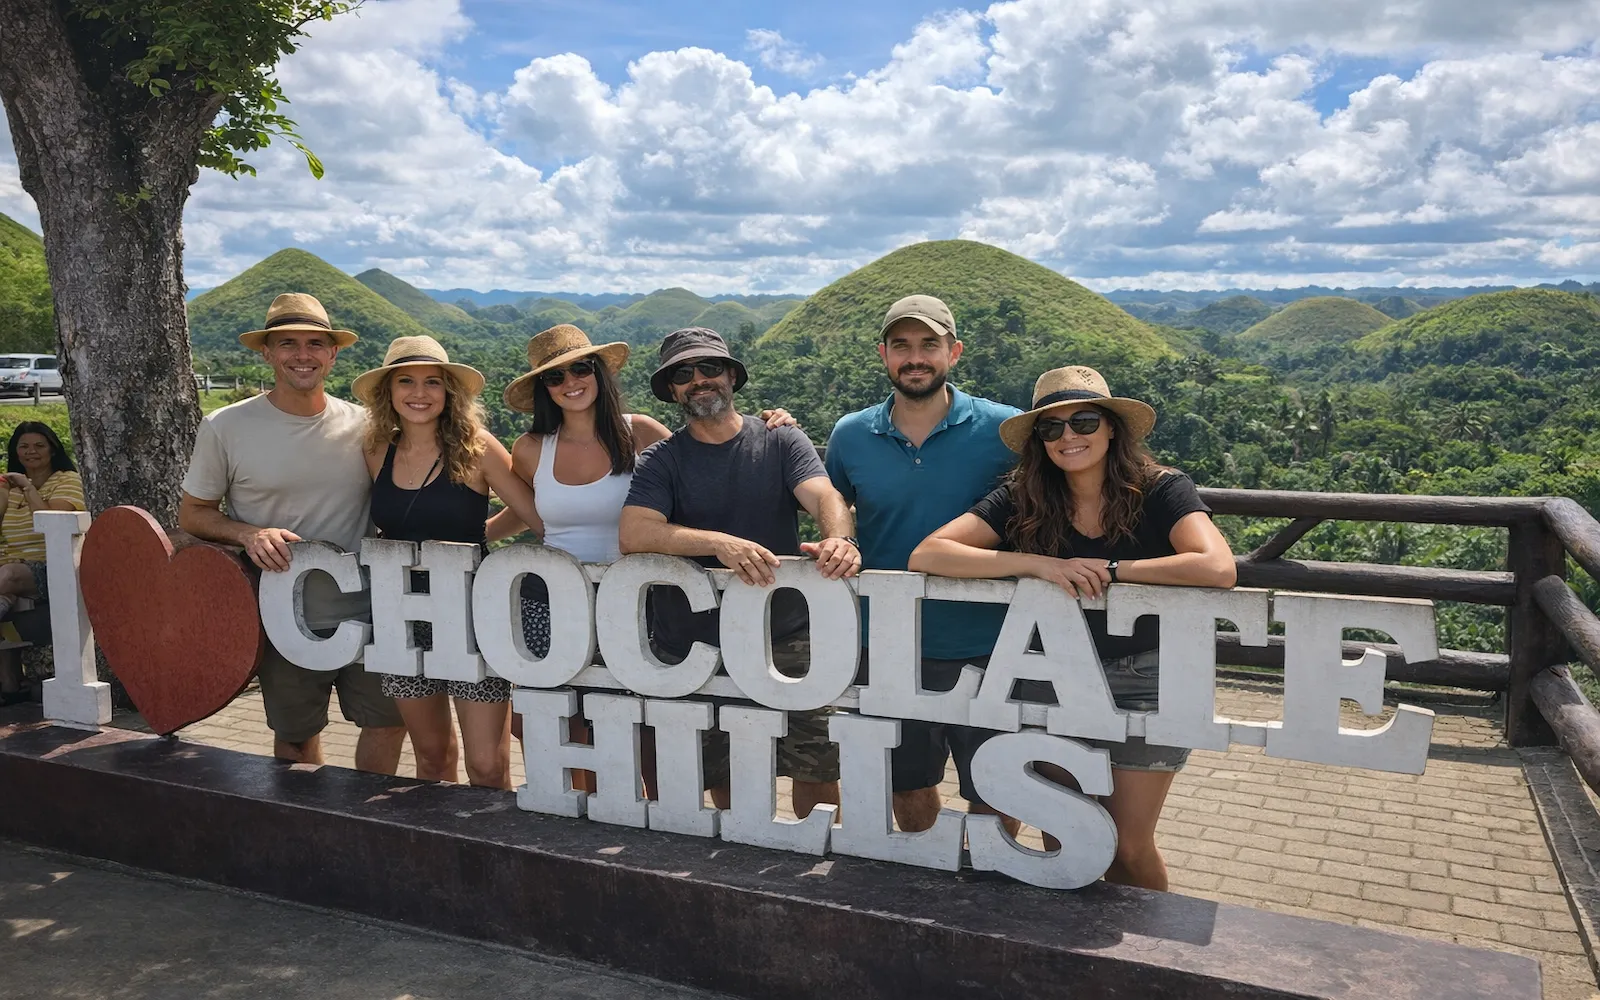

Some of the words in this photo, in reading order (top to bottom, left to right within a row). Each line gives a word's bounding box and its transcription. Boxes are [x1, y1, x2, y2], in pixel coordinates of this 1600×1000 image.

[33, 510, 112, 729] I
[258, 538, 1438, 775] CHOCOLATE
[512, 688, 1118, 889] HILLS
